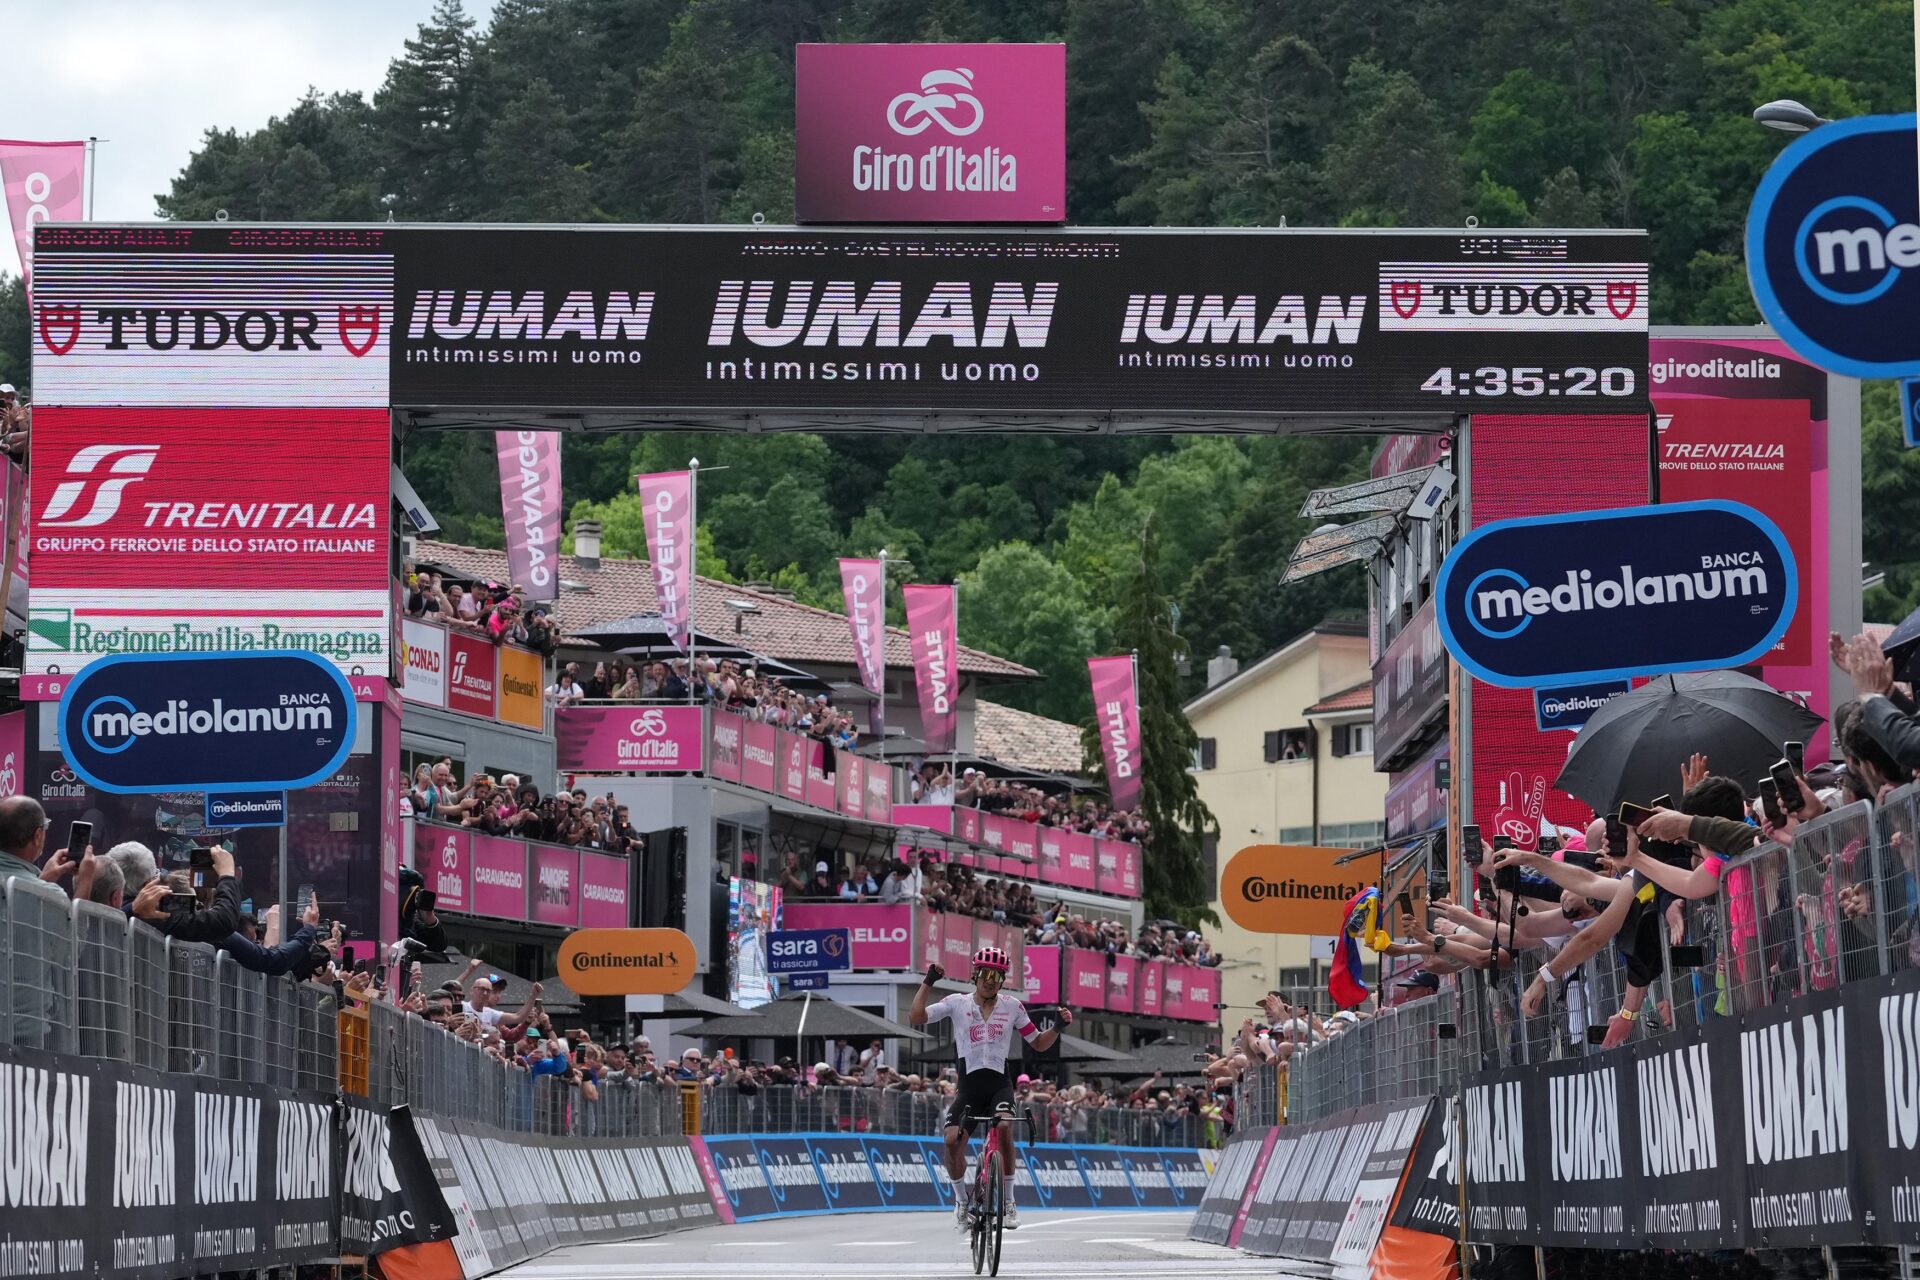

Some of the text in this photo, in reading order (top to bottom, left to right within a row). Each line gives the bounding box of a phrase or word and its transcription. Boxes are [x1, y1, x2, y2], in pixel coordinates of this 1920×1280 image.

[853, 145, 1016, 191] Giro d'Italia
[1433, 284, 1595, 316] TUDOR
[407, 290, 655, 340] IUMAN
[707, 280, 1059, 347] IUMAN
[1120, 294, 1367, 344] IUMAN
[99, 309, 323, 351] TUDOR
[406, 346, 641, 364] intimissimi uomo
[1119, 351, 1353, 367] intimissimi uomo
[706, 357, 1039, 381] intimissimi uomo
[1421, 367, 1635, 396] 4:35:20
[1665, 444, 1785, 458] TRENITALIA
[1690, 462, 1716, 470] DELLO
[143, 503, 375, 528] TRENITALIA
[37, 538, 375, 553] GRUPPO FERROVIE DELLO STATO ITALIANE
[1701, 551, 1764, 569] BANCA
[1477, 565, 1768, 620] mediolanum
[408, 646, 440, 673] CONAD
[464, 675, 492, 692] TRENITALIA
[503, 673, 535, 697] Continental
[279, 693, 330, 705] BANCA
[1545, 694, 1612, 714] mediolan
[94, 699, 332, 737] mediolanum
[618, 739, 641, 758] Giro
[42, 784, 58, 796] Giro
[1529, 780, 1544, 819] TOYOTA
[213, 801, 282, 813] mediolanum
[475, 867, 522, 889] CARAVAGGIO
[539, 867, 569, 888] AMORE
[583, 884, 625, 904] CARAVAGGIO
[772, 940, 817, 956] sara
[572, 952, 664, 972] Continental
[781, 960, 818, 968] assicura
[794, 978, 813, 986] sara
[1079, 971, 1100, 988] DANTE
[1740, 1005, 1848, 1165] IUMAN
[1637, 1043, 1717, 1178] IUMAN
[1549, 1067, 1622, 1182] IUMAN
[113, 1080, 176, 1209] IUMAN
[194, 1091, 260, 1206] IUMAN
[276, 1100, 332, 1201] IUMAN
[1505, 1206, 1527, 1231] uomo
[1554, 1201, 1623, 1233] intimissimi uomo
[1696, 1200, 1721, 1230] uomo
[1750, 1188, 1817, 1229] intimissimi
[1820, 1186, 1851, 1224] uomo
[236, 1227, 255, 1254] uomo
[313, 1220, 329, 1245] uomo
[58, 1239, 83, 1272] uomo
[157, 1234, 175, 1264] uomo
